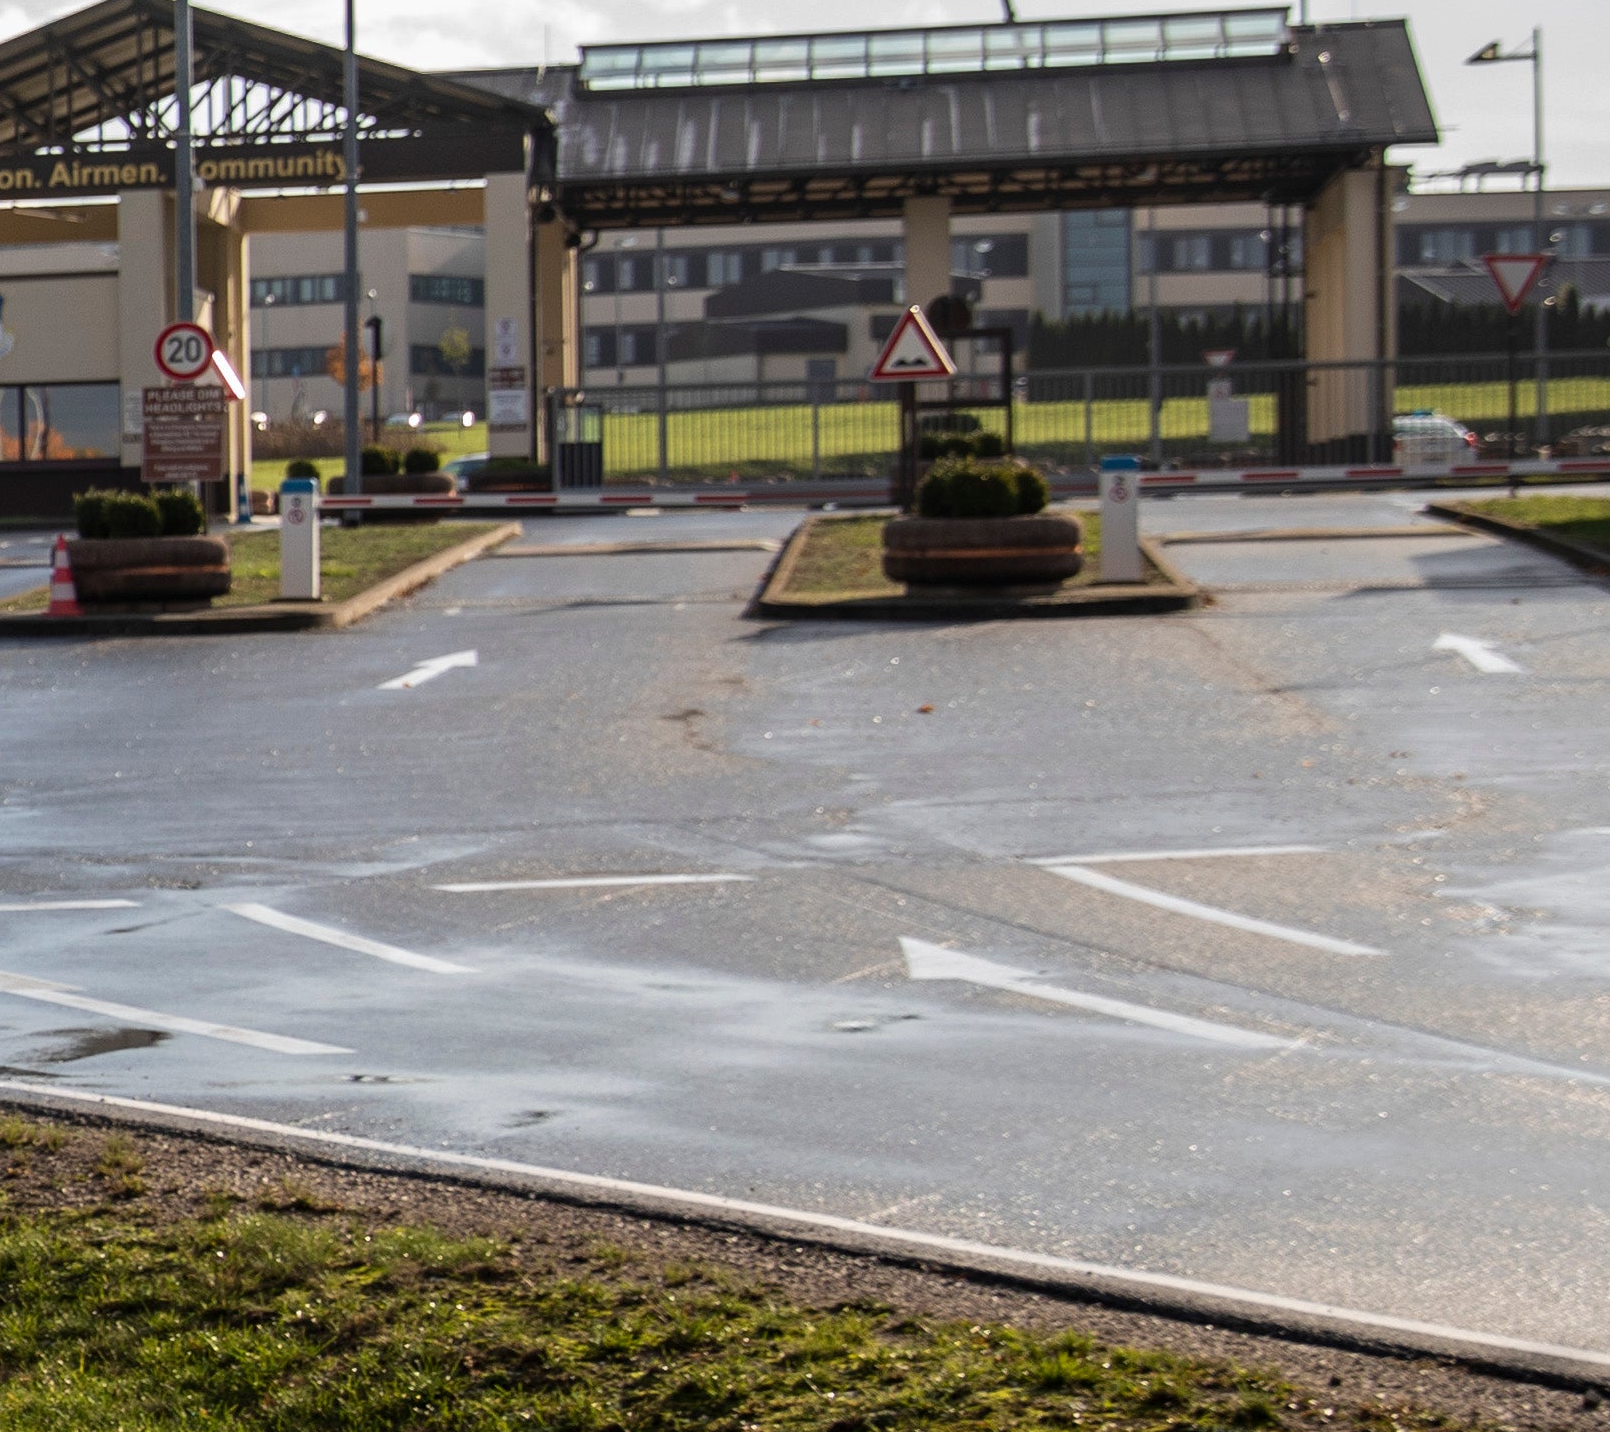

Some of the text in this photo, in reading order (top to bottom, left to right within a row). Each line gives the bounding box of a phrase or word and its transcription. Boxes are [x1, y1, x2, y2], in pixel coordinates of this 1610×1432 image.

[48, 161, 167, 188] Airmen.
[169, 335, 201, 363] 20
[147, 389, 195, 402] PLEASE
